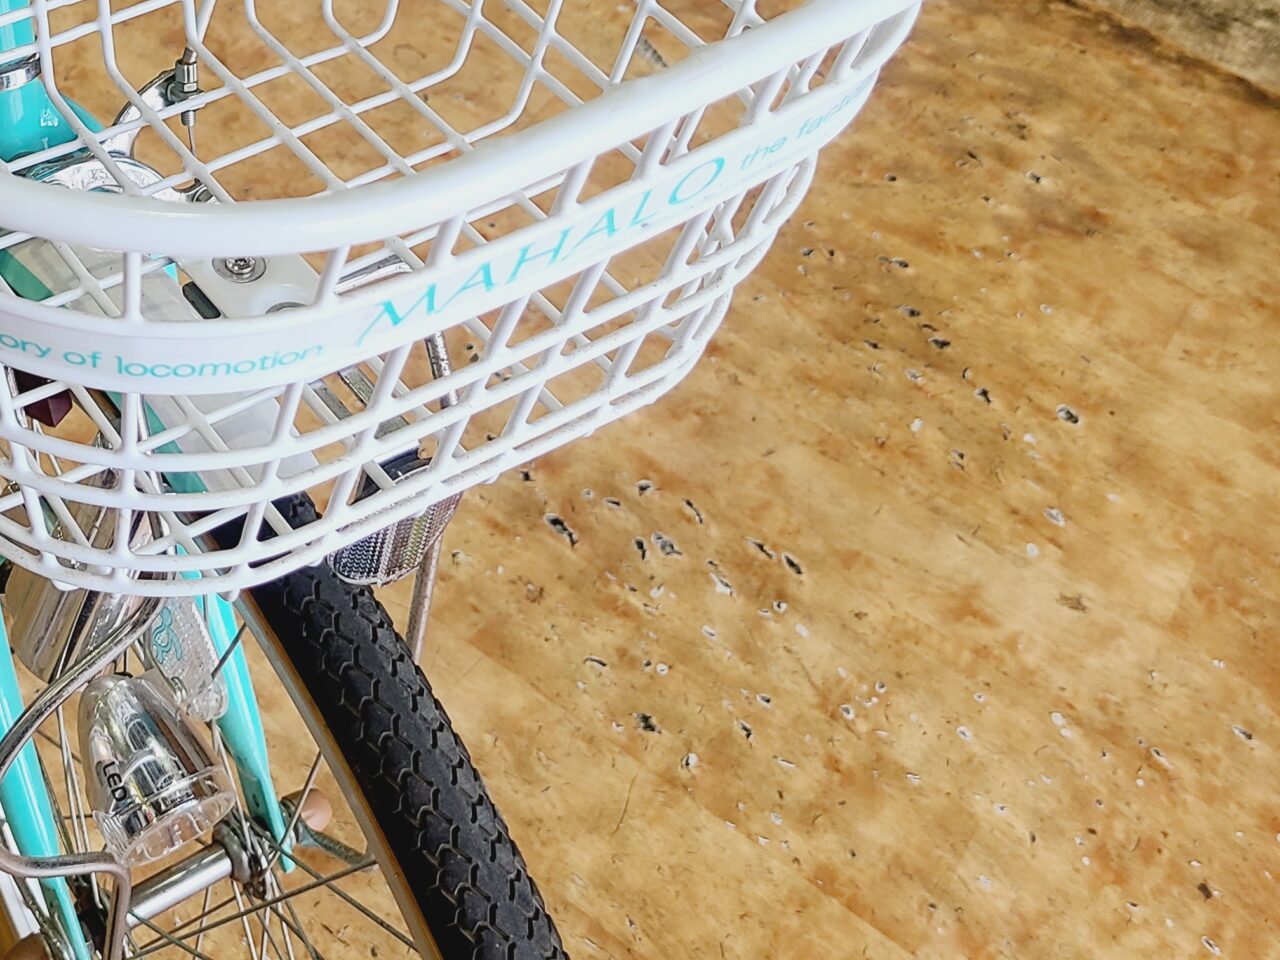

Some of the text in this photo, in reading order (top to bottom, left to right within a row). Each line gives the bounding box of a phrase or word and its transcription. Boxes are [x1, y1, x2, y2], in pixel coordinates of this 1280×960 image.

[356, 156, 725, 348] MAHALO
[63, 350, 101, 369] of
[114, 344, 323, 378] locomotion
[102, 761, 129, 802] LED
